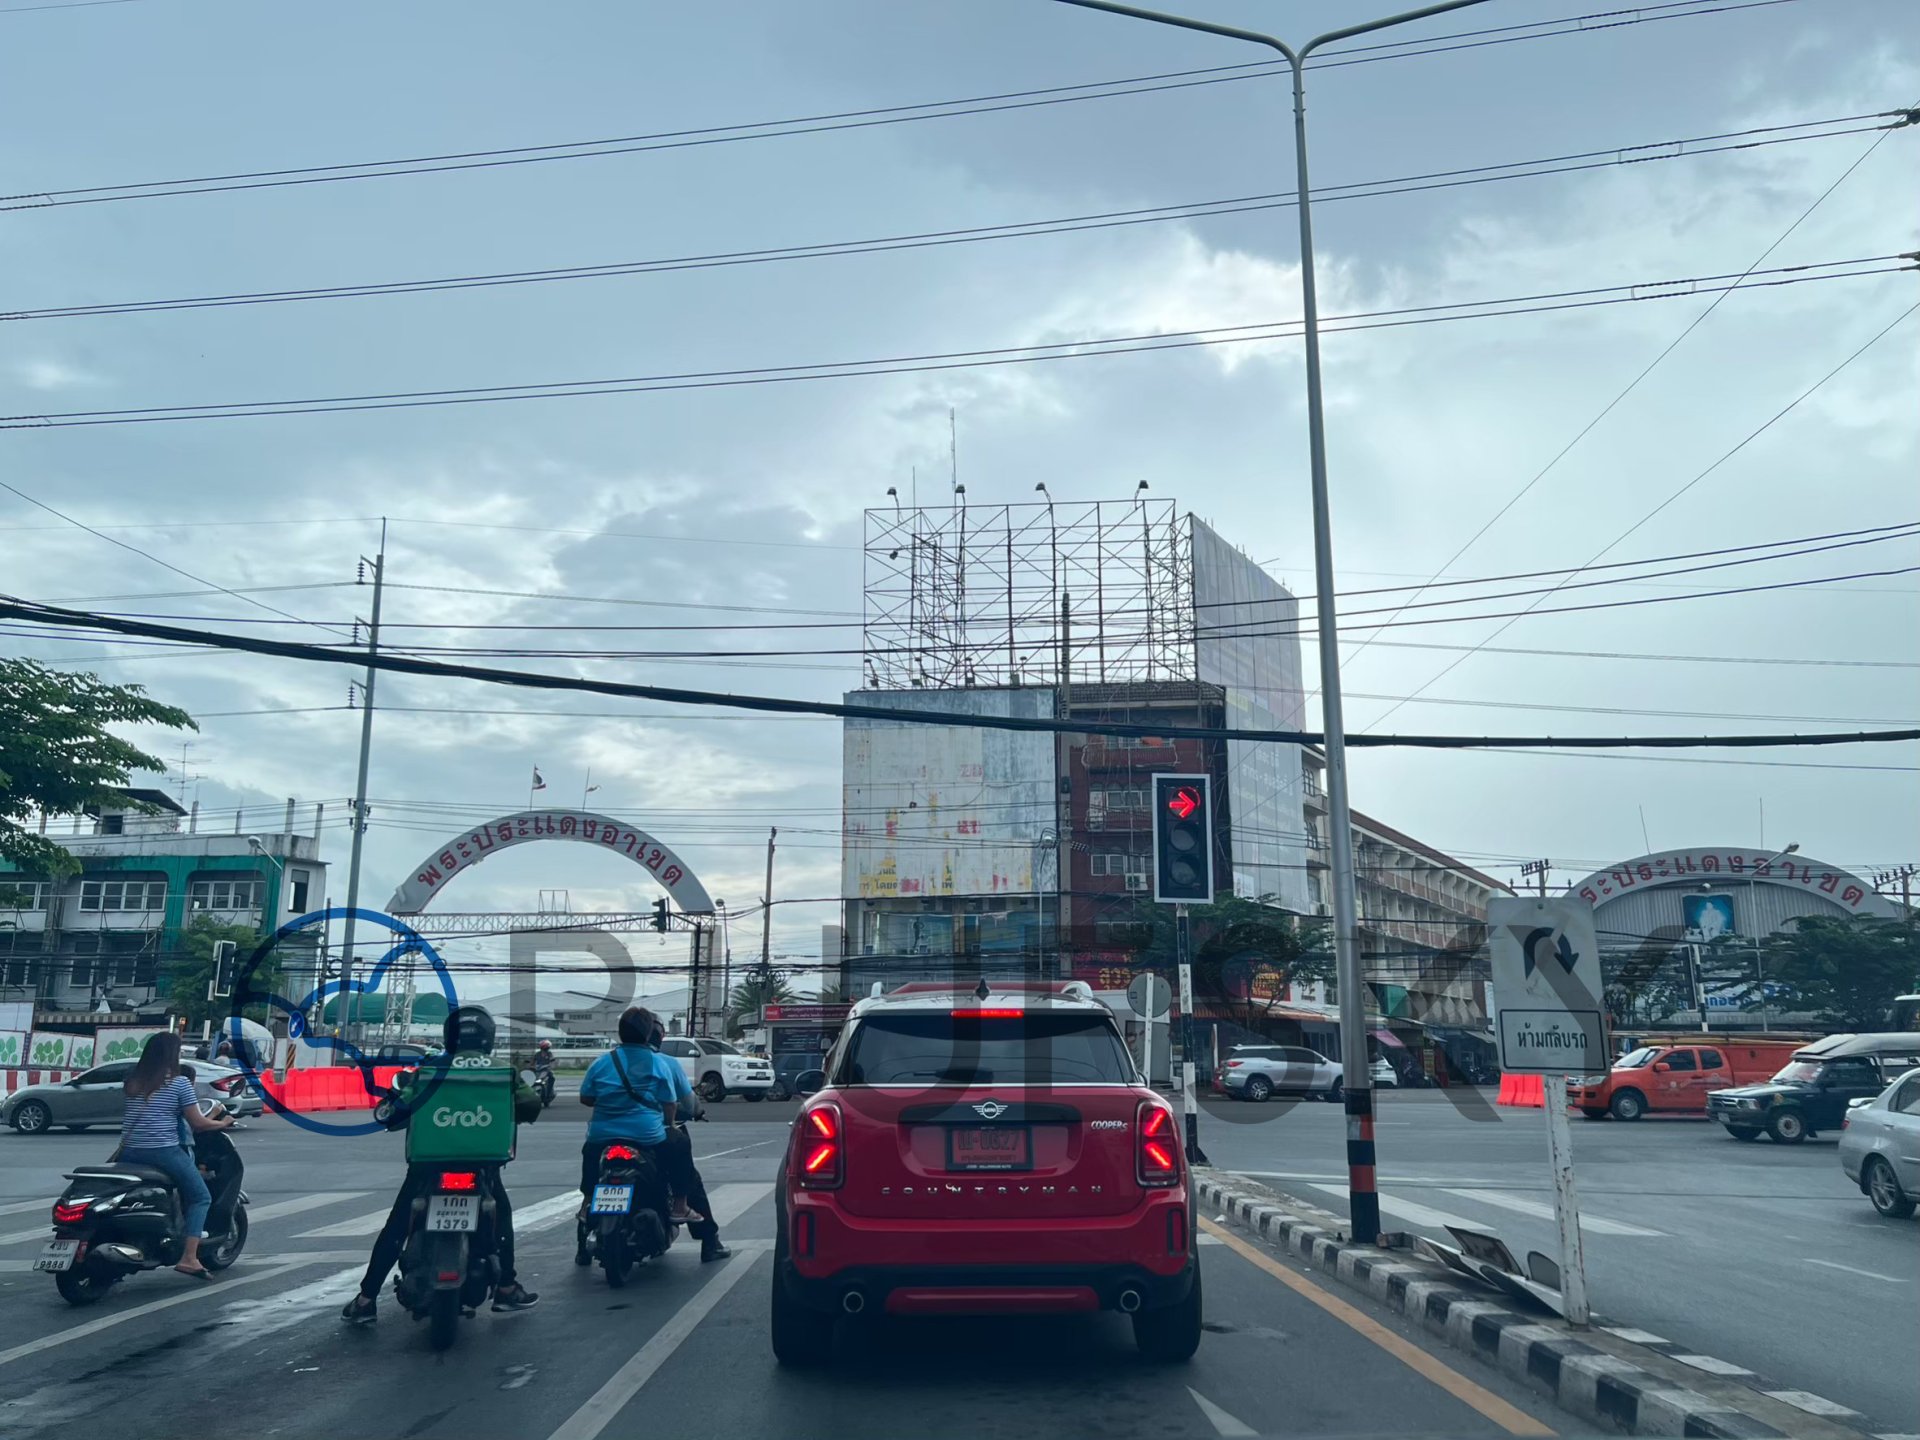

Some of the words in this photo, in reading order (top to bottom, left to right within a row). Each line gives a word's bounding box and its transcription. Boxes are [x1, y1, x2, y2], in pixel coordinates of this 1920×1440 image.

[417, 815, 684, 887] พระประแดงอาเขต
[1579, 854, 1864, 907] ระประแดงอาเขต
[1517, 1022, 1588, 1049] ห้ามกลับรถ
[452, 1056, 491, 1068] Grab
[433, 1105, 492, 1128] Grab
[881, 1184, 1102, 1195] COUNTRYMAN
[436, 1219, 469, 1229] 1379
